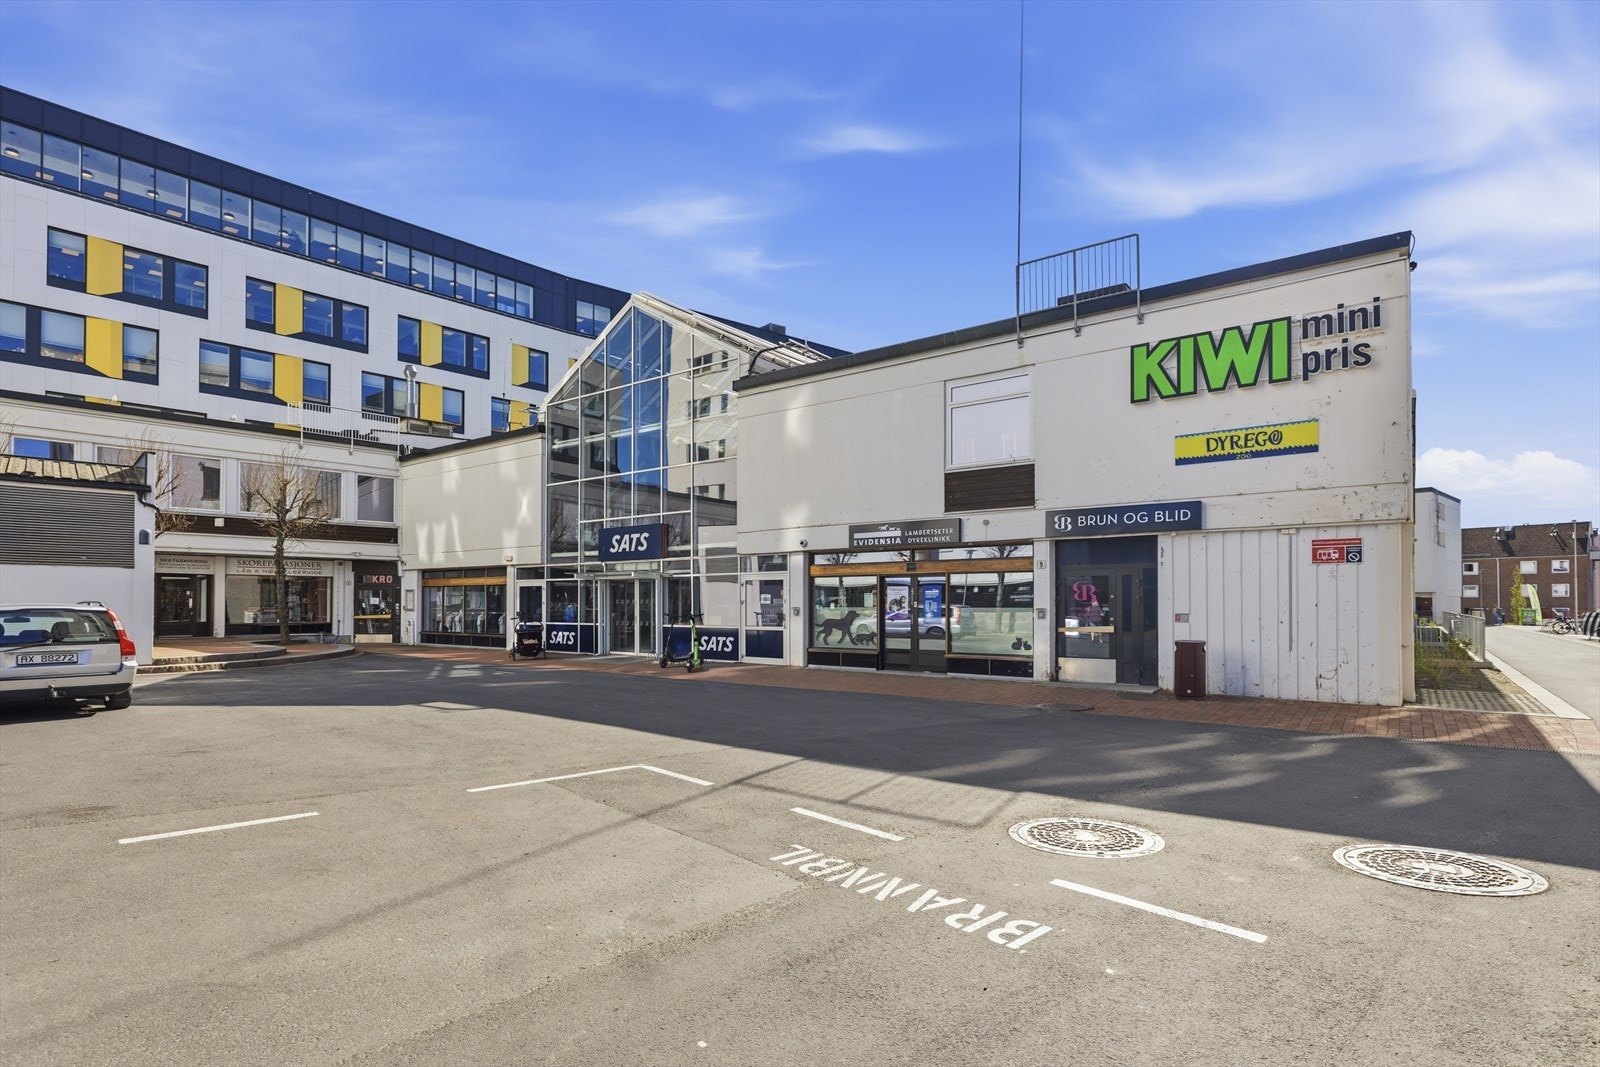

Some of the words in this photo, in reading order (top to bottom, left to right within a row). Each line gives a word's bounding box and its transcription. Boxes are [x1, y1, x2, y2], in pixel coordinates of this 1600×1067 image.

[1302, 296, 1382, 340] mini
[1130, 316, 1292, 404] KIWI
[1302, 338, 1372, 382] pris
[1206, 429, 1283, 453] DYREGO
[1077, 514, 1118, 527] BRUN
[1123, 511, 1148, 524] OG
[1154, 509, 1191, 523] BLID
[904, 527, 954, 537] LAMBERTSETER
[907, 535, 951, 544] DYREKLINIKK
[609, 532, 650, 553] SATS
[853, 537, 902, 546] EVIDENSIA
[371, 575, 393, 584] KRO
[549, 631, 576, 645] SATS
[699, 636, 735, 652] SATS
[20, 656, 35, 664] AX
[40, 654, 75, 663] 88272
